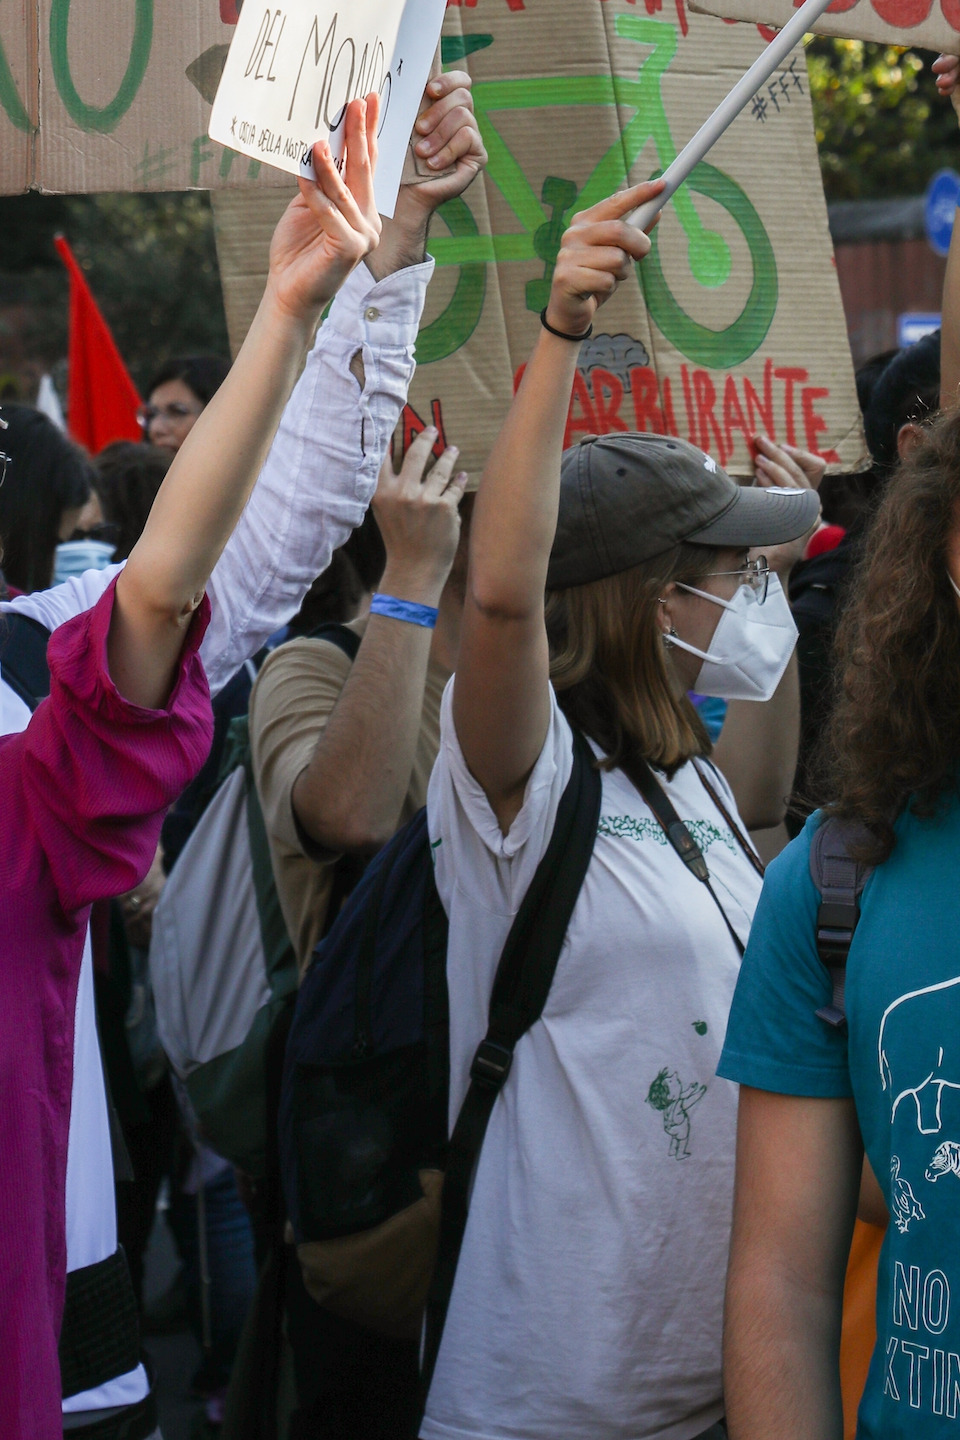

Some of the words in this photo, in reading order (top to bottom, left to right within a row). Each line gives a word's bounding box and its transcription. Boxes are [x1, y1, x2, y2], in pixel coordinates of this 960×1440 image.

[243, 8, 287, 82] DEL
[750, 56, 805, 124] #FFF
[257, 127, 283, 156] DELLA
[282, 136, 315, 168] NOSTRA
[513, 357, 841, 471] ARBURANTE
[893, 1260, 950, 1335] NO
